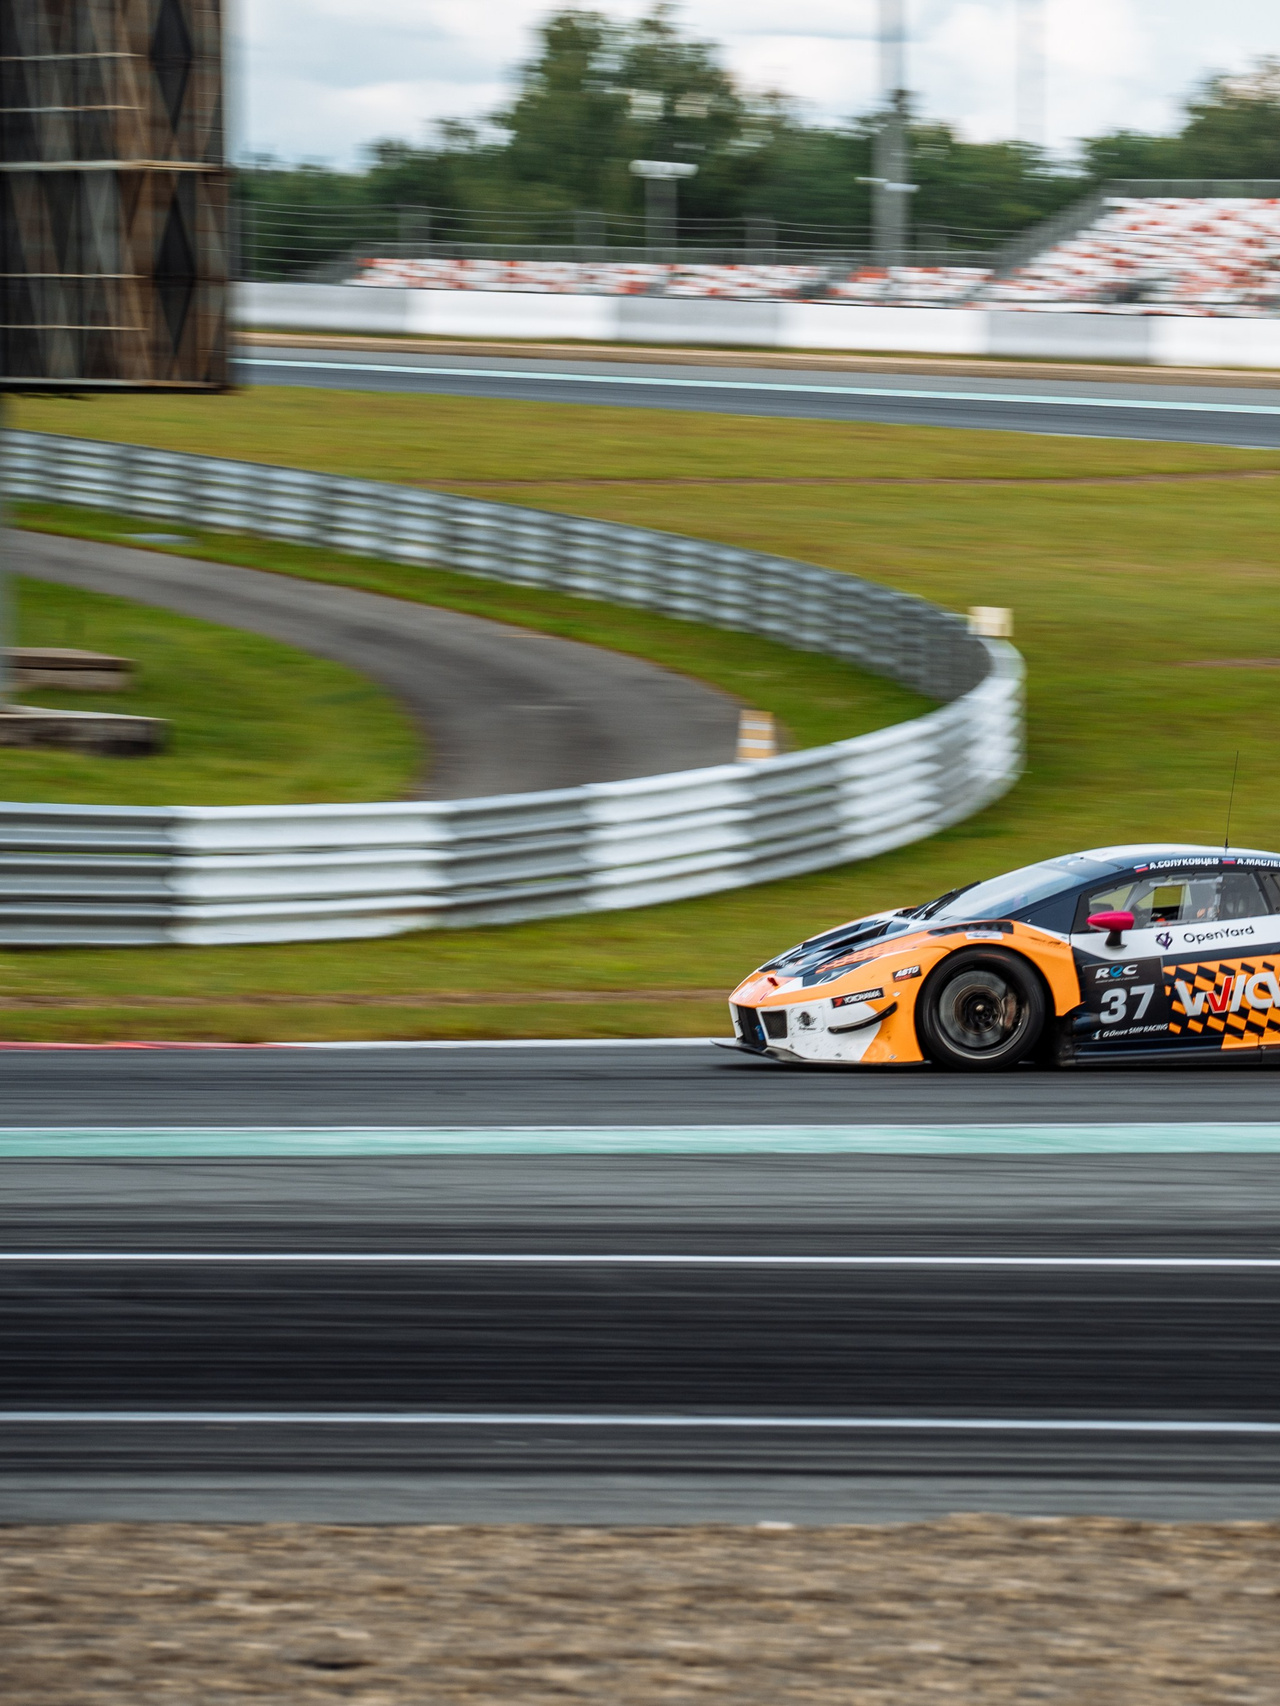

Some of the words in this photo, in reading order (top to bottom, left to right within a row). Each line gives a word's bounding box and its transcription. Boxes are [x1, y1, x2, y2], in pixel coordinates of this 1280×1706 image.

[1183, 925, 1254, 944] OpenYard
[1100, 983, 1155, 1024] 37
[1143, 1022, 1169, 1033] RACING
